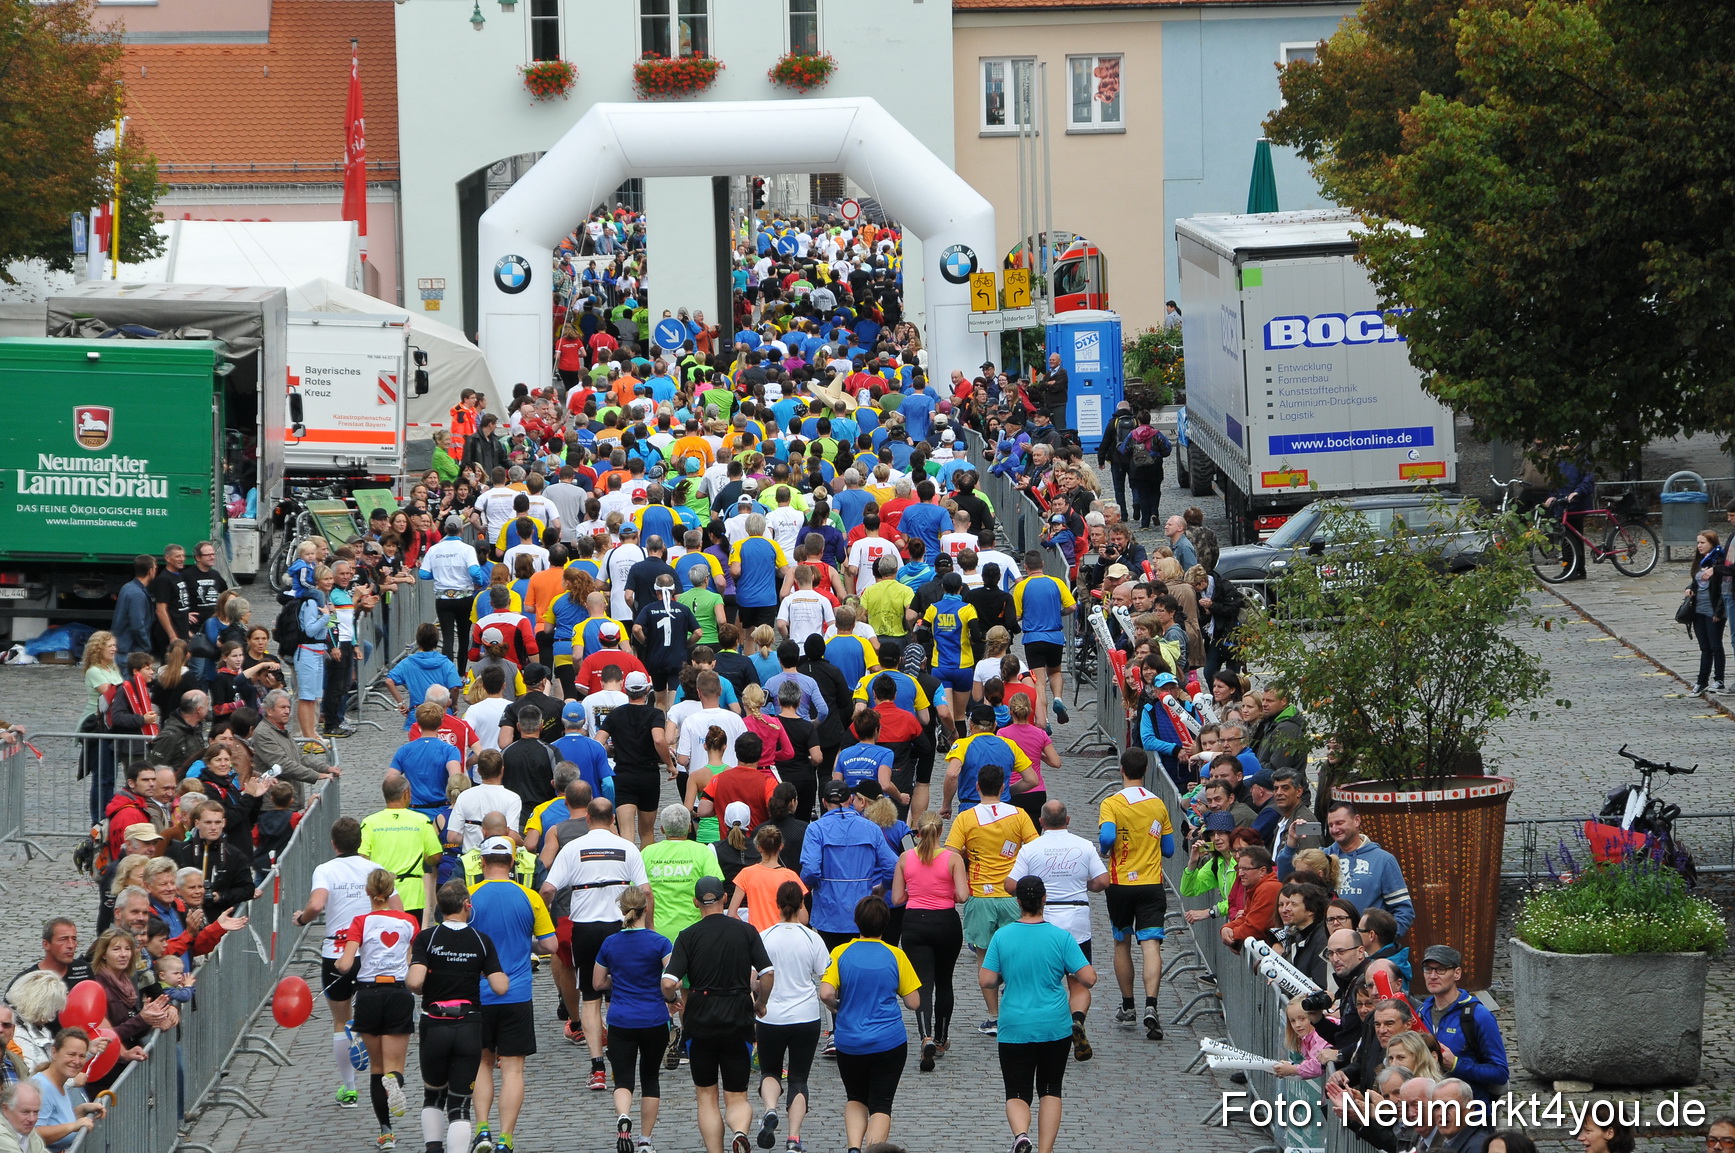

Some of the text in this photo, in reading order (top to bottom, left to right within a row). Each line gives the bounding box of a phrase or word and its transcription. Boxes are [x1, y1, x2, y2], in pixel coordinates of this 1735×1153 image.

[942, 245, 974, 259] BMW
[496, 255, 529, 269] BMW
[305, 366, 361, 376] Bayerisches
[1278, 362, 1333, 373] Entwicklung
[305, 377, 331, 386] Rotes
[1278, 374, 1329, 384] Formenbau
[304, 388, 331, 397] Kreuz
[1278, 384, 1358, 397] Kunststofftechnik
[1279, 396, 1378, 409] Aluminium-Druckguss
[333, 414, 392, 422] Katastrophenschutz
[1280, 411, 1315, 422] Logistik
[1291, 433, 1413, 450] www.bockonline.de
[38, 453, 149, 473] Neumarkter
[17, 469, 168, 498] Lammsbräu
[16, 504, 167, 516] DAS FEINE ÖKOLOGISCHE BIER
[46, 517, 137, 527] www.lammsbraeu.de
[657, 617, 671, 646] 1
[1041, 847, 1082, 878] Julia
[664, 865, 693, 877] DAV
[333, 883, 348, 891] Lauf,
[1279, 978, 1302, 997] BMW
